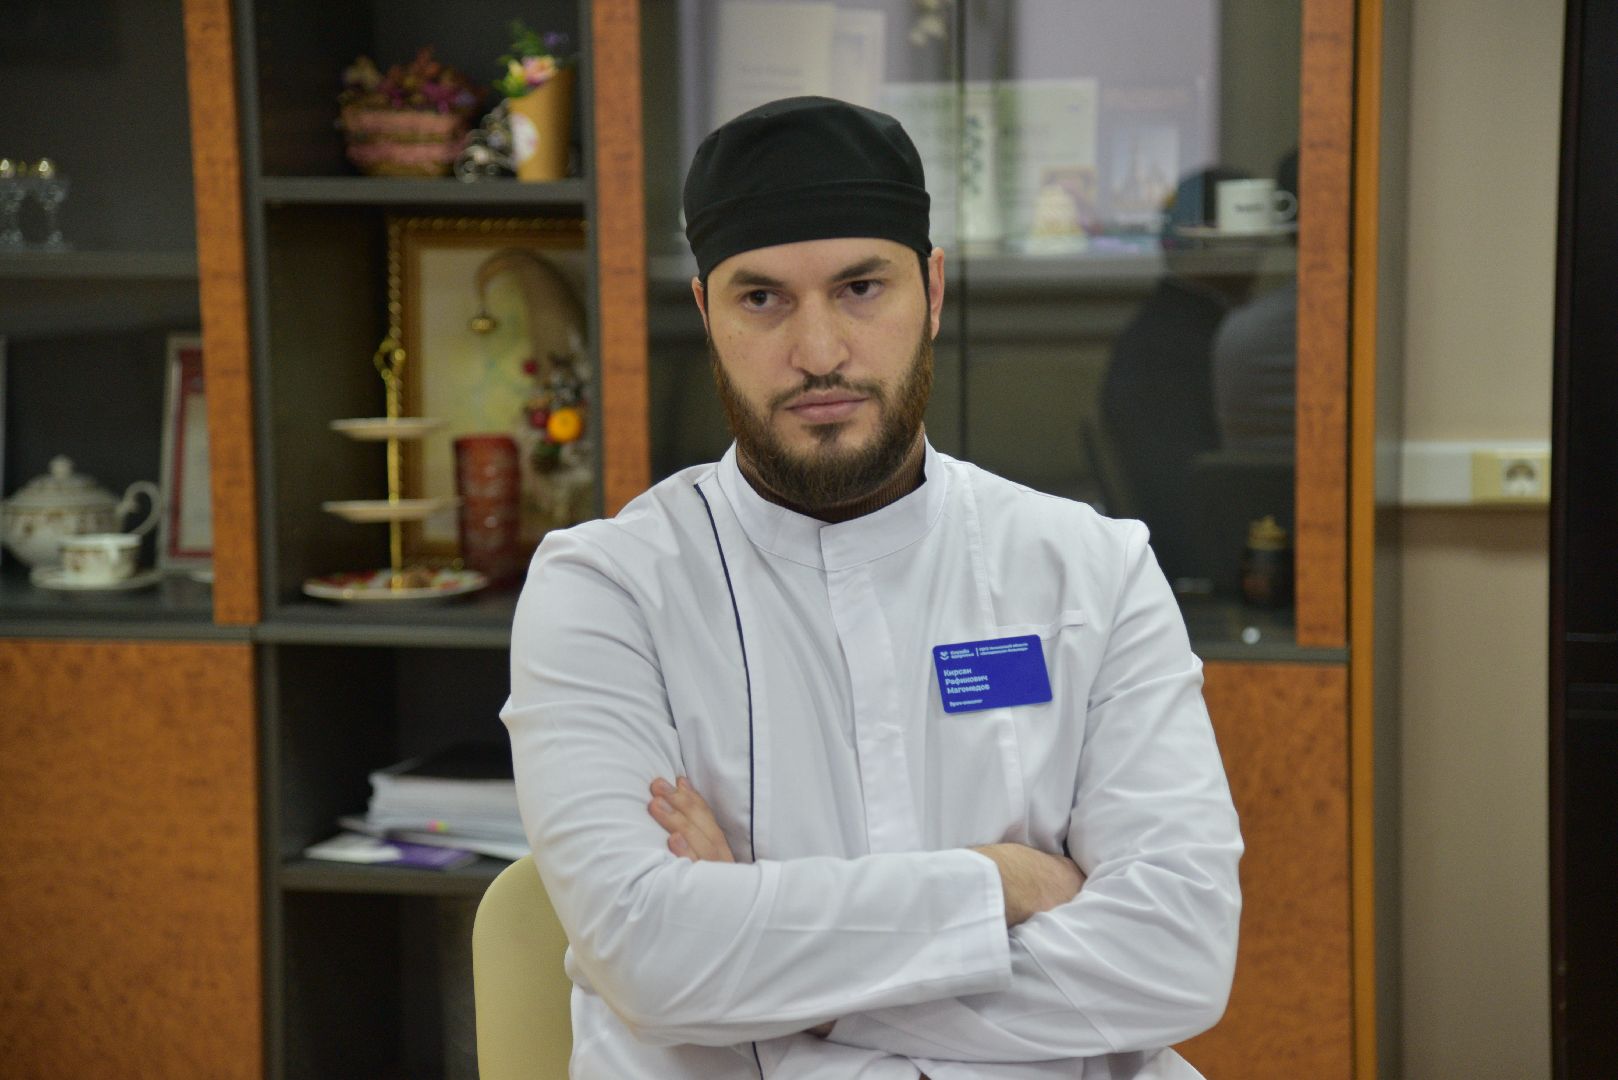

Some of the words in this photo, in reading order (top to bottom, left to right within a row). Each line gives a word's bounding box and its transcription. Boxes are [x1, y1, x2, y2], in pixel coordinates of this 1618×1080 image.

[943, 668, 972, 677] Кирсан
[945, 675, 988, 686] Рафикович
[947, 684, 990, 695] Магомедов
